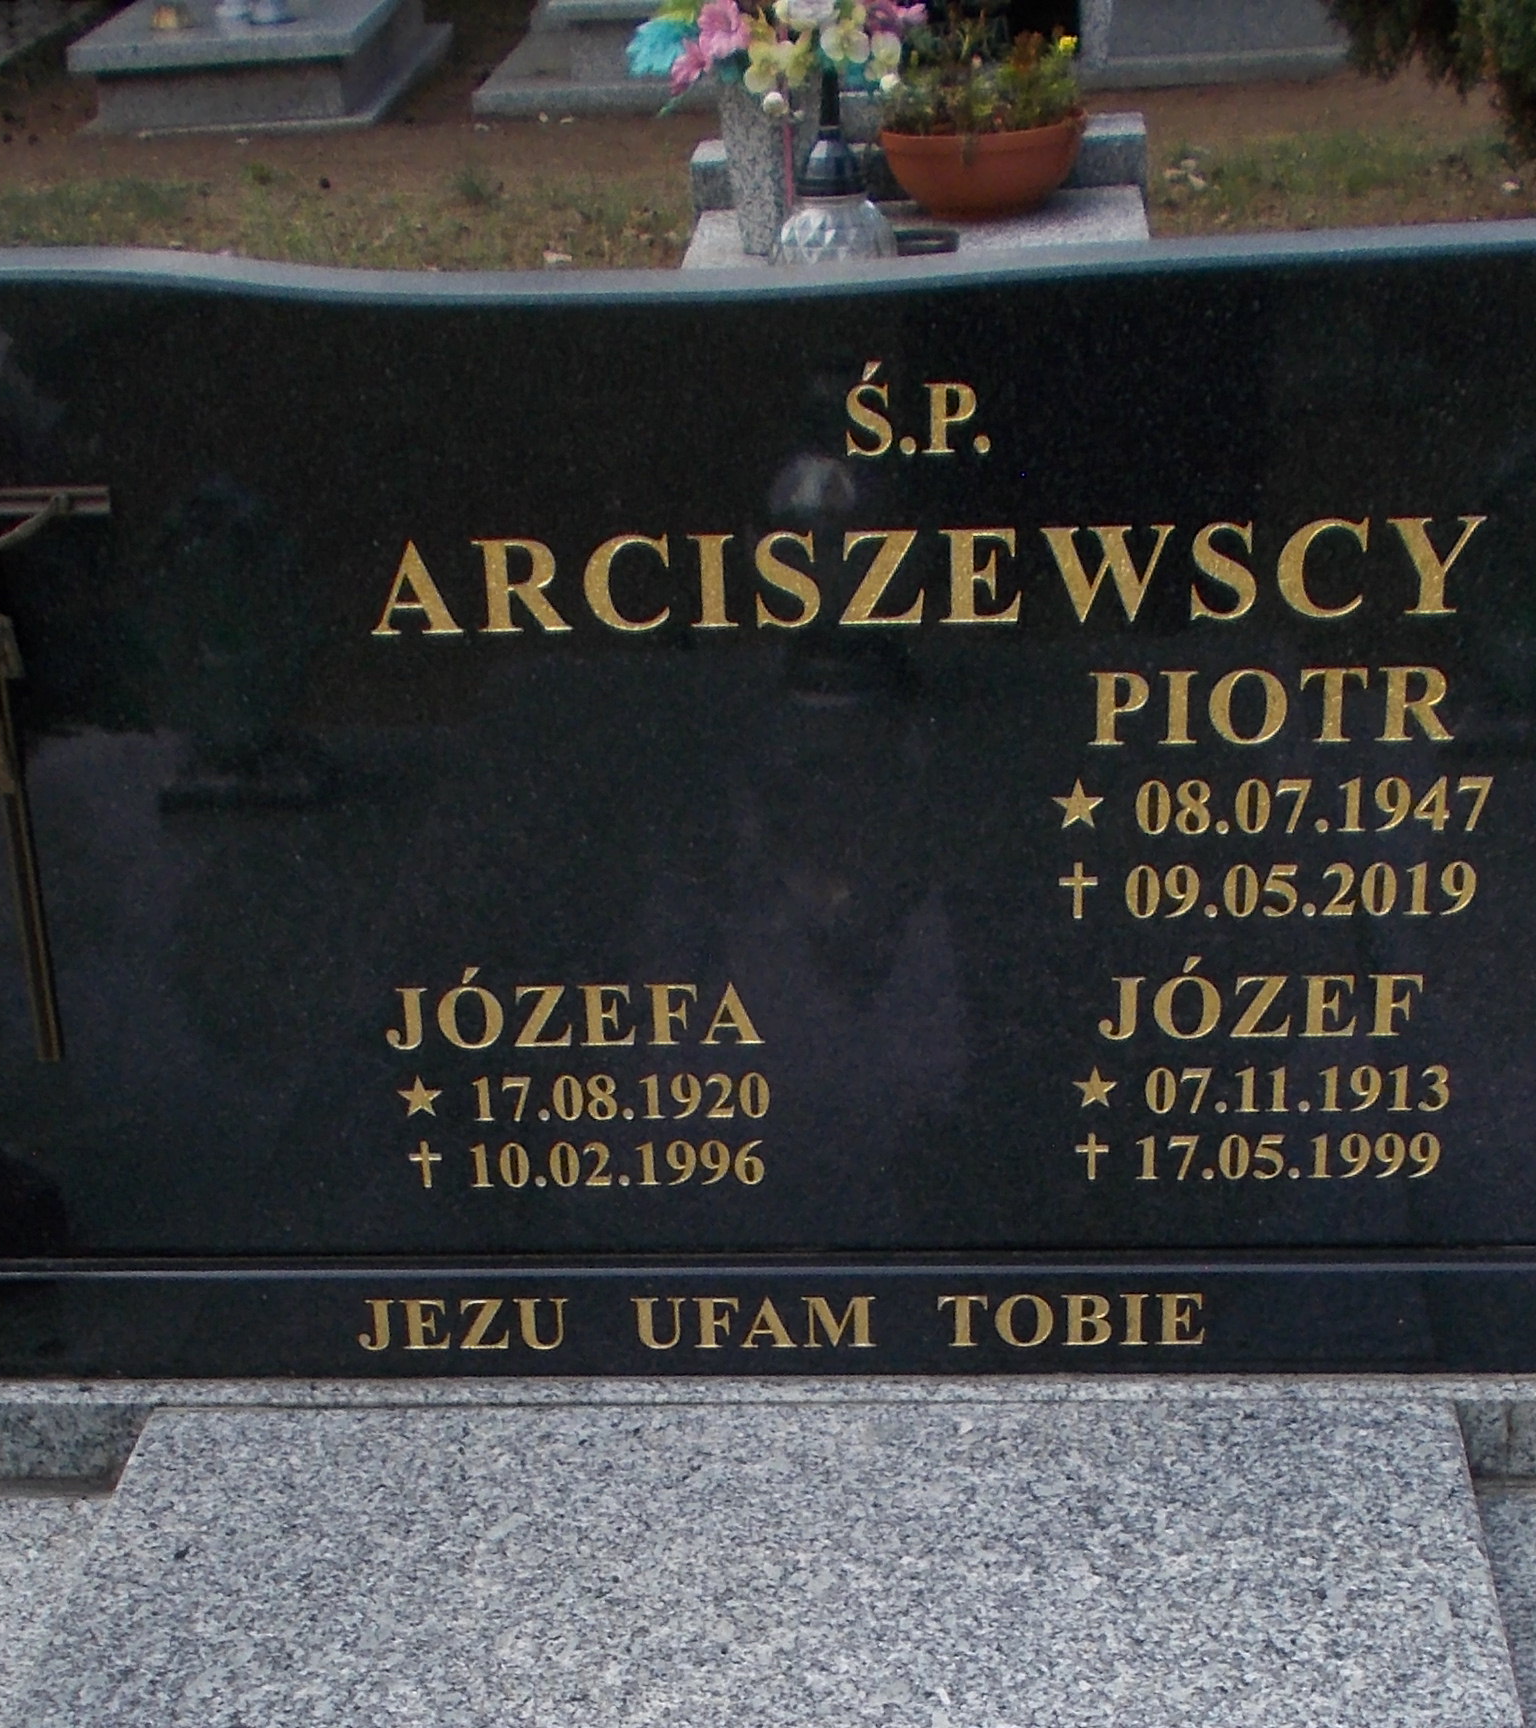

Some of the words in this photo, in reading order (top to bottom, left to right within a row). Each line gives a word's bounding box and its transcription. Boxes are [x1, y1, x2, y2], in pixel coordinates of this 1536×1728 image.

[845, 361, 991, 457] Ś.P.
[371, 514, 1485, 636] ARCISZEWSCY
[1088, 664, 1454, 746] PIOTR
[1134, 775, 1493, 835] 08.07.1947
[1124, 860, 1478, 918] 09.05.2019
[385, 966, 765, 1050] JÓZEFA
[1098, 955, 1424, 1041] JÓZEF
[471, 1071, 771, 1122] 17.08.1920
[1144, 1064, 1451, 1114] 07.11.1913
[469, 1139, 766, 1188] 10.02.1996
[1135, 1131, 1441, 1181] 17.05.1999
[359, 1296, 568, 1353] JEZU
[635, 1295, 877, 1350] UFAM
[938, 1292, 1207, 1348] TOBIE
